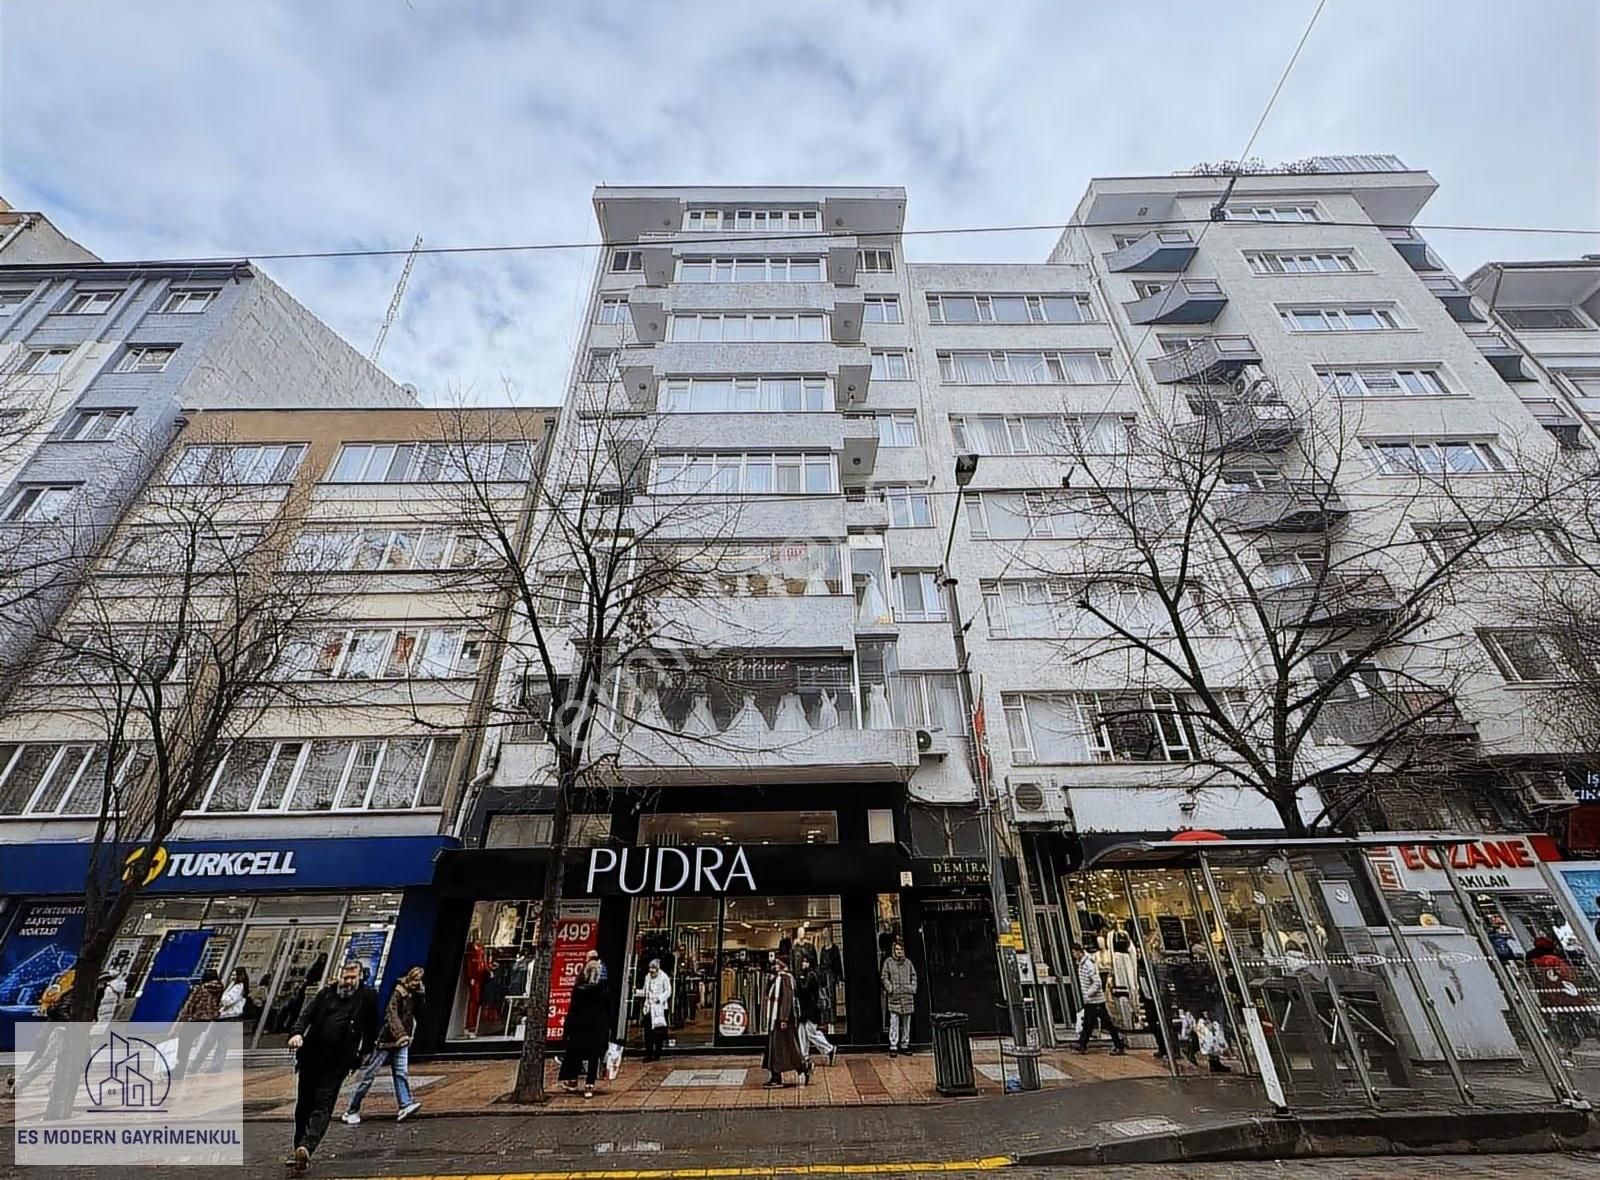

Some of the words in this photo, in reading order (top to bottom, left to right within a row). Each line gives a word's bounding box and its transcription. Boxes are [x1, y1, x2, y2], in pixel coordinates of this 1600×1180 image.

[168, 852, 296, 877] TURKCELL
[933, 859, 988, 873] DEMİRA
[1398, 840, 1535, 870] ECZANE
[586, 845, 757, 894] PUDRA
[557, 923, 591, 942] 499
